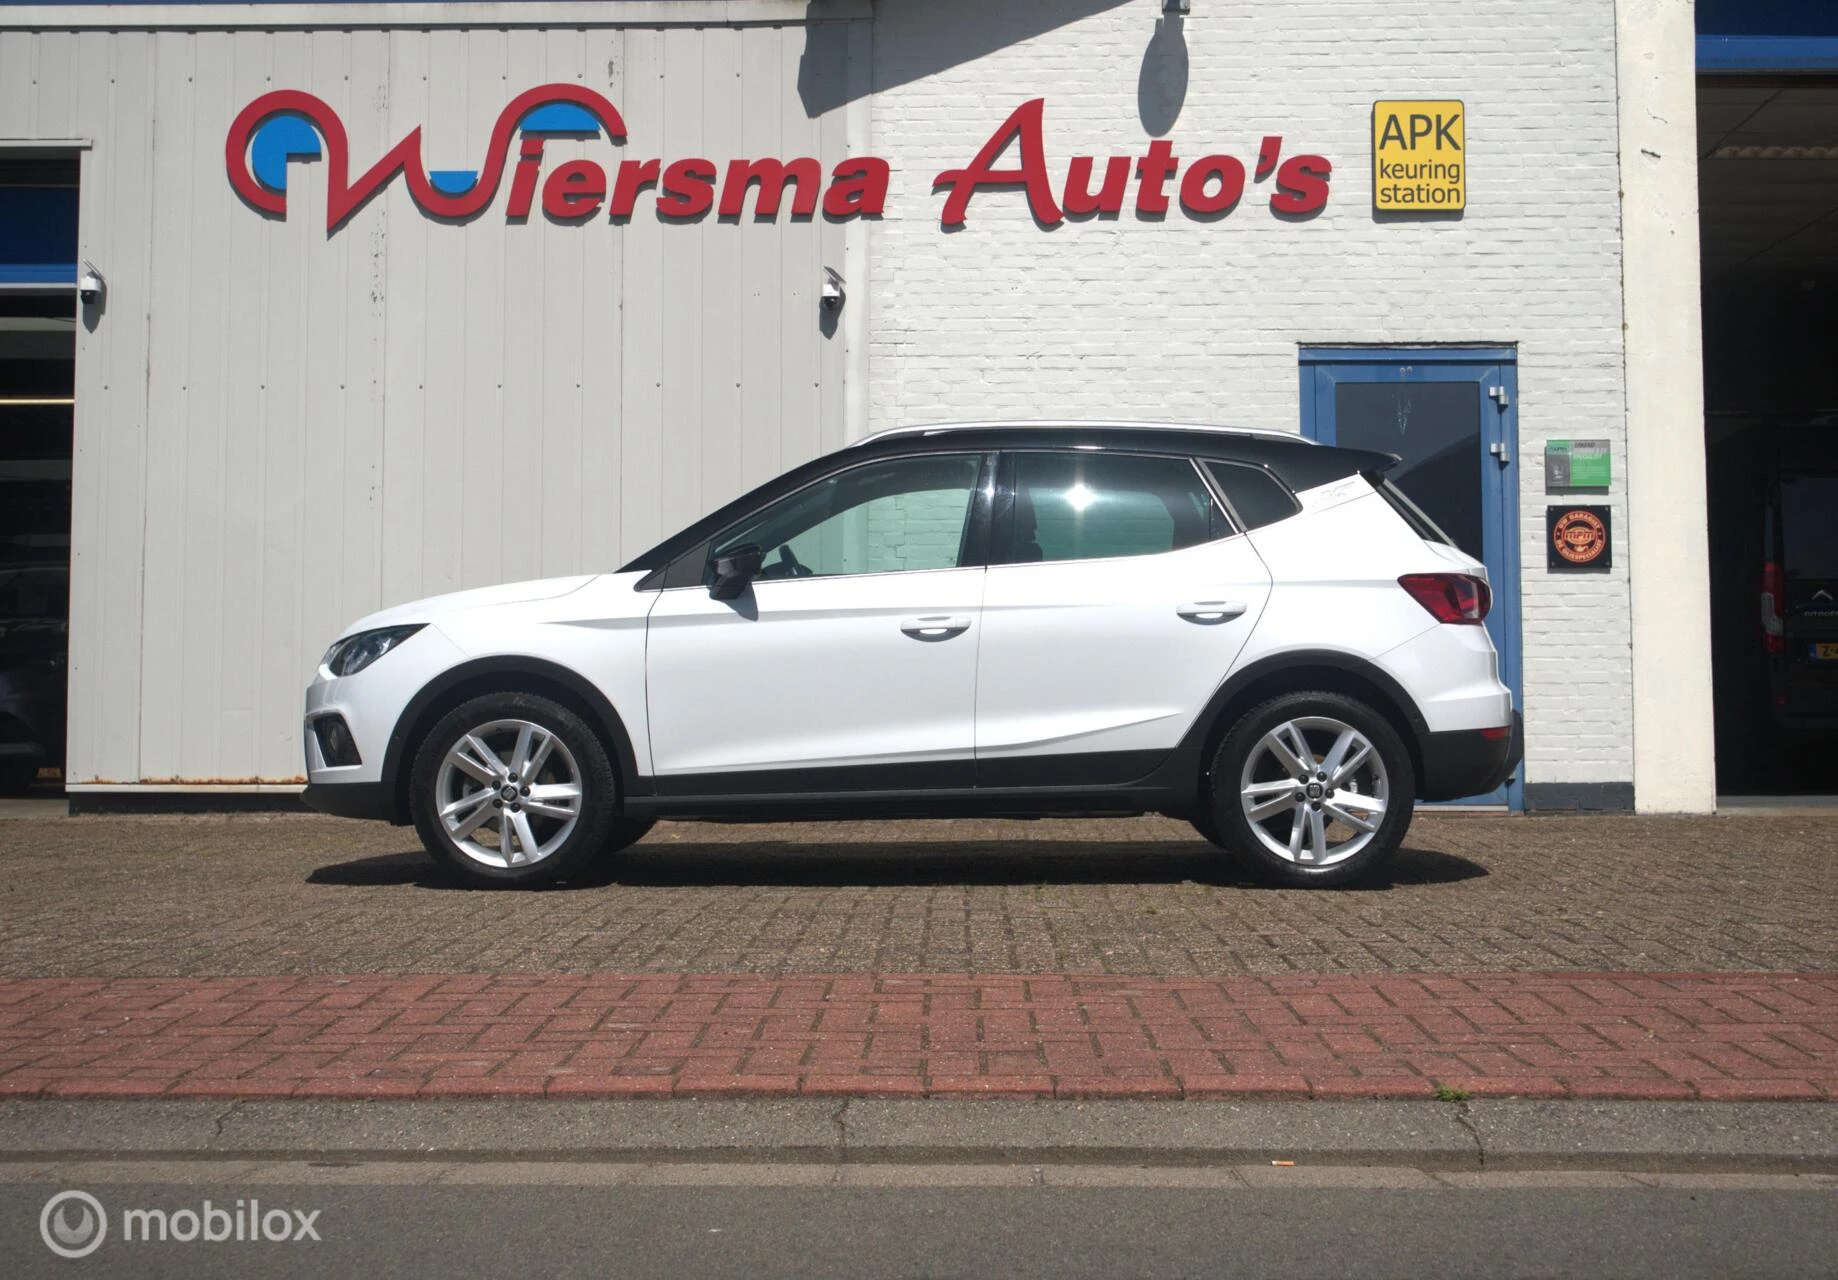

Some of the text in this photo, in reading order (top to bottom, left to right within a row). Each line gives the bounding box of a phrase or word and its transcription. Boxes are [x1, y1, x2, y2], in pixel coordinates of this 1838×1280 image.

[1379, 114, 1461, 151] APK
[226, 83, 1332, 233] Wiersma Auto's
[1380, 158, 1460, 185] keuring
[1380, 183, 1460, 204] station
